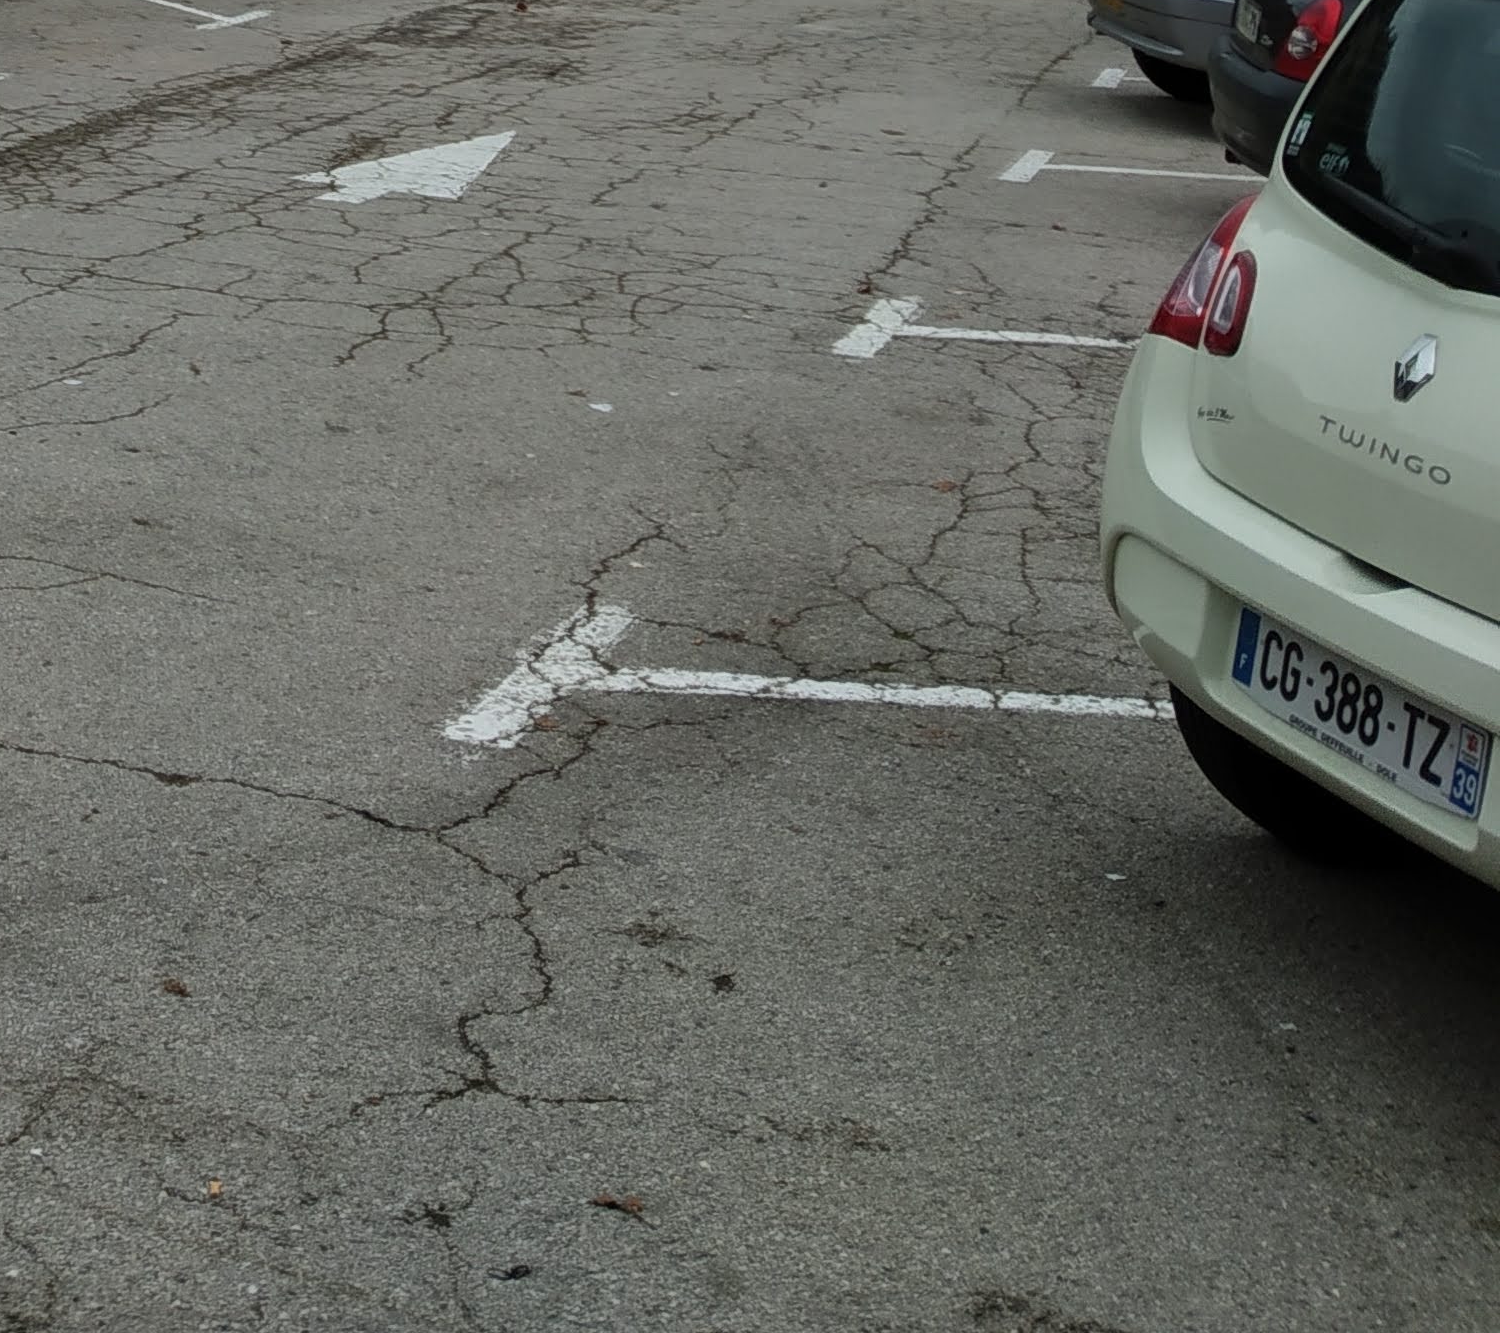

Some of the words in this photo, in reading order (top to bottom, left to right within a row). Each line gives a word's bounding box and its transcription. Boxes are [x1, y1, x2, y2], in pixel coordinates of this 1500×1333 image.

[1319, 414, 1451, 485] TWINGO
[1239, 653, 1248, 669] F
[1260, 630, 1451, 787] CG-388-TZ
[1453, 767, 1476, 806] 39
